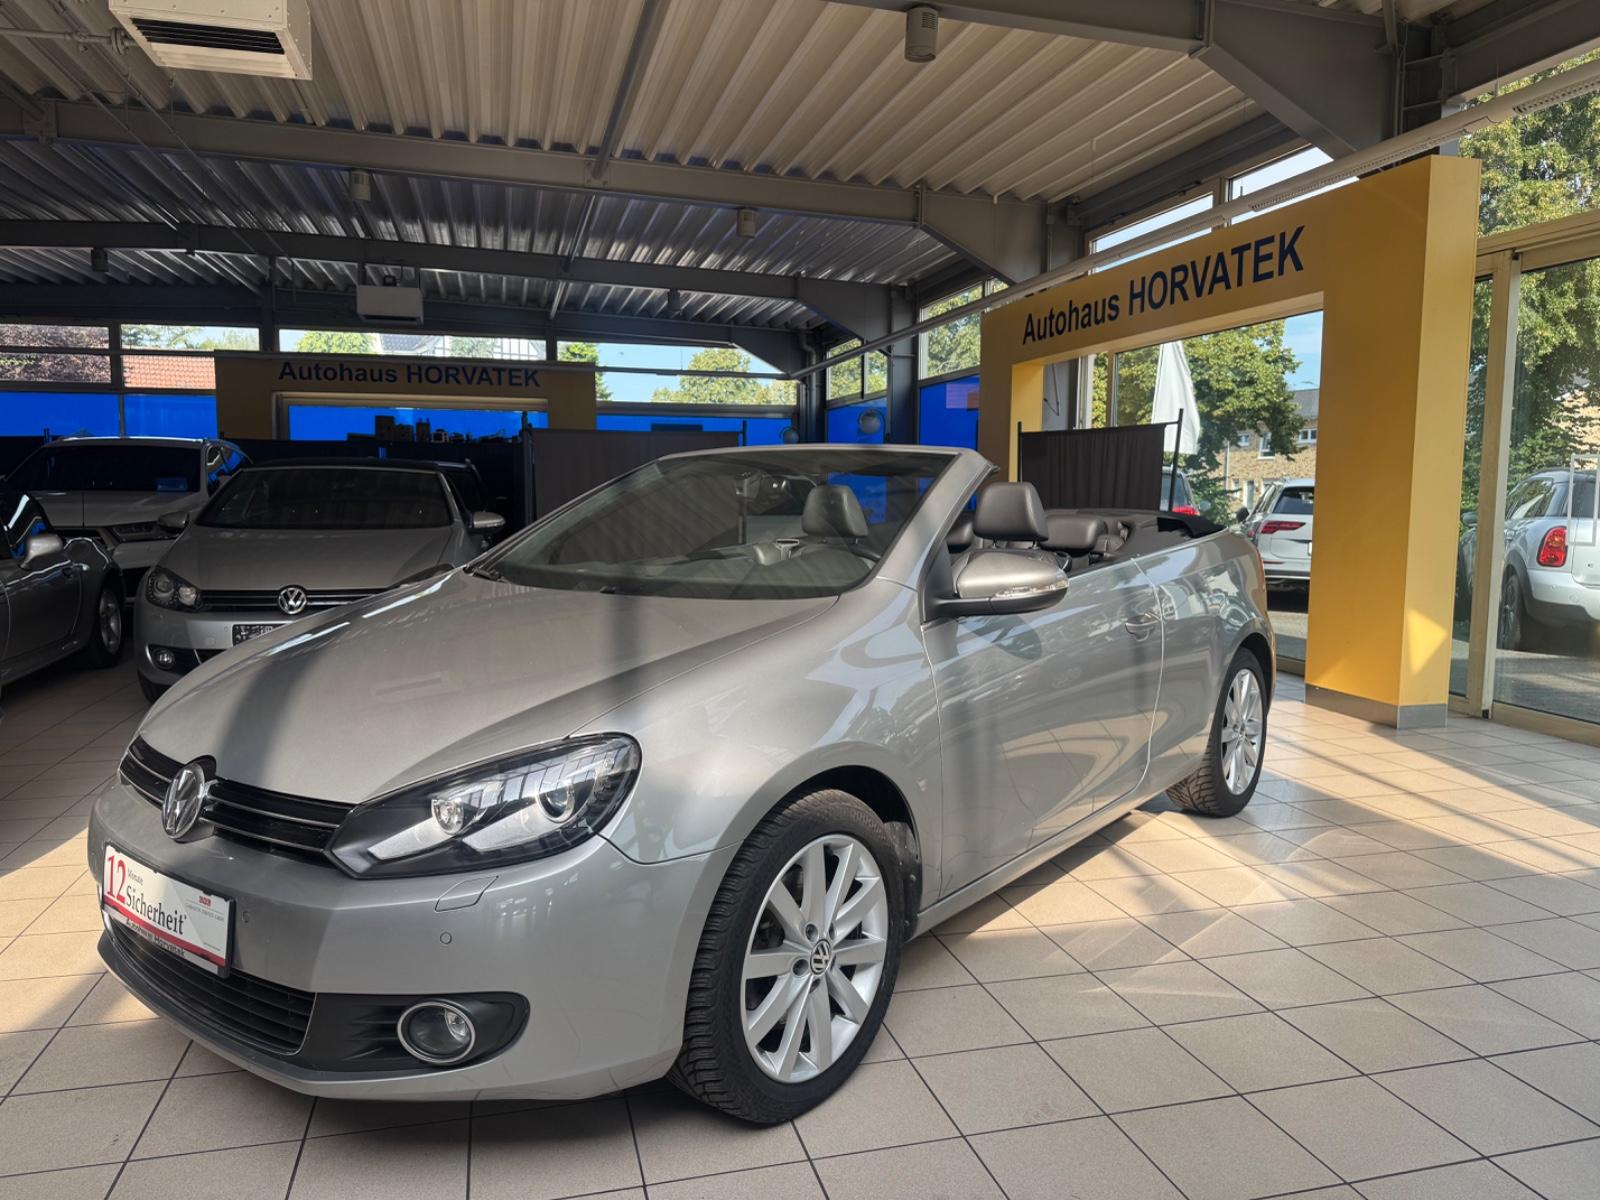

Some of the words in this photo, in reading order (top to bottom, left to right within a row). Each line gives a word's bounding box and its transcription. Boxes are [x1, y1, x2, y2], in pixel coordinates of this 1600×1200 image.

[1022, 294, 1120, 345] Autohaus
[1128, 225, 1305, 316] HORVATEK
[278, 362, 398, 383] Autohaus
[406, 364, 540, 388] HORVATEK
[107, 855, 126, 904] 12
